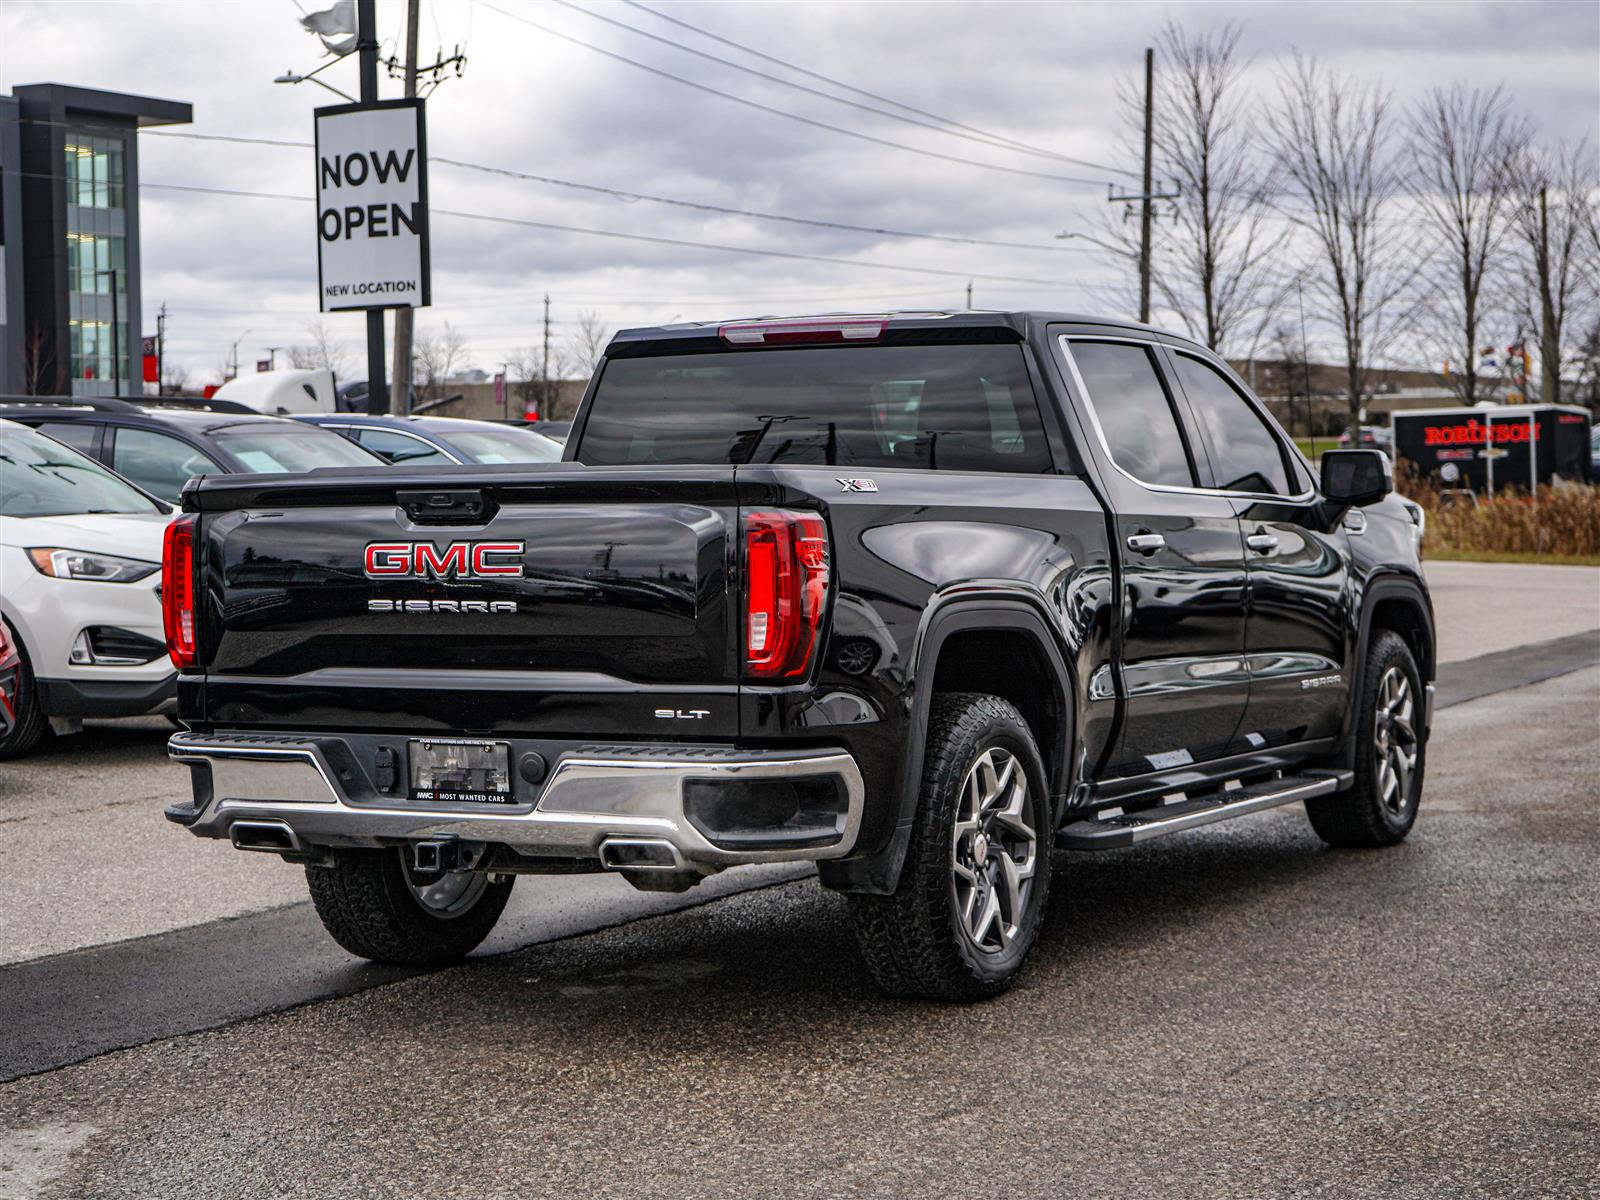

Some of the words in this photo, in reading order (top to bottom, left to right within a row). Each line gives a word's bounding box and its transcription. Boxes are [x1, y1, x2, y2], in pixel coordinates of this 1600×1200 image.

[321, 149, 415, 190] NOW
[320, 202, 421, 242] OPEN
[325, 284, 350, 297] NEW
[352, 280, 416, 295] LOCATION
[364, 541, 525, 579] GMC
[367, 599, 518, 614] SIERRA
[1301, 674, 1342, 689] SIERRA
[654, 709, 711, 719] SLT
[439, 792, 456, 800] MOST
[458, 793, 487, 802] WANTED
